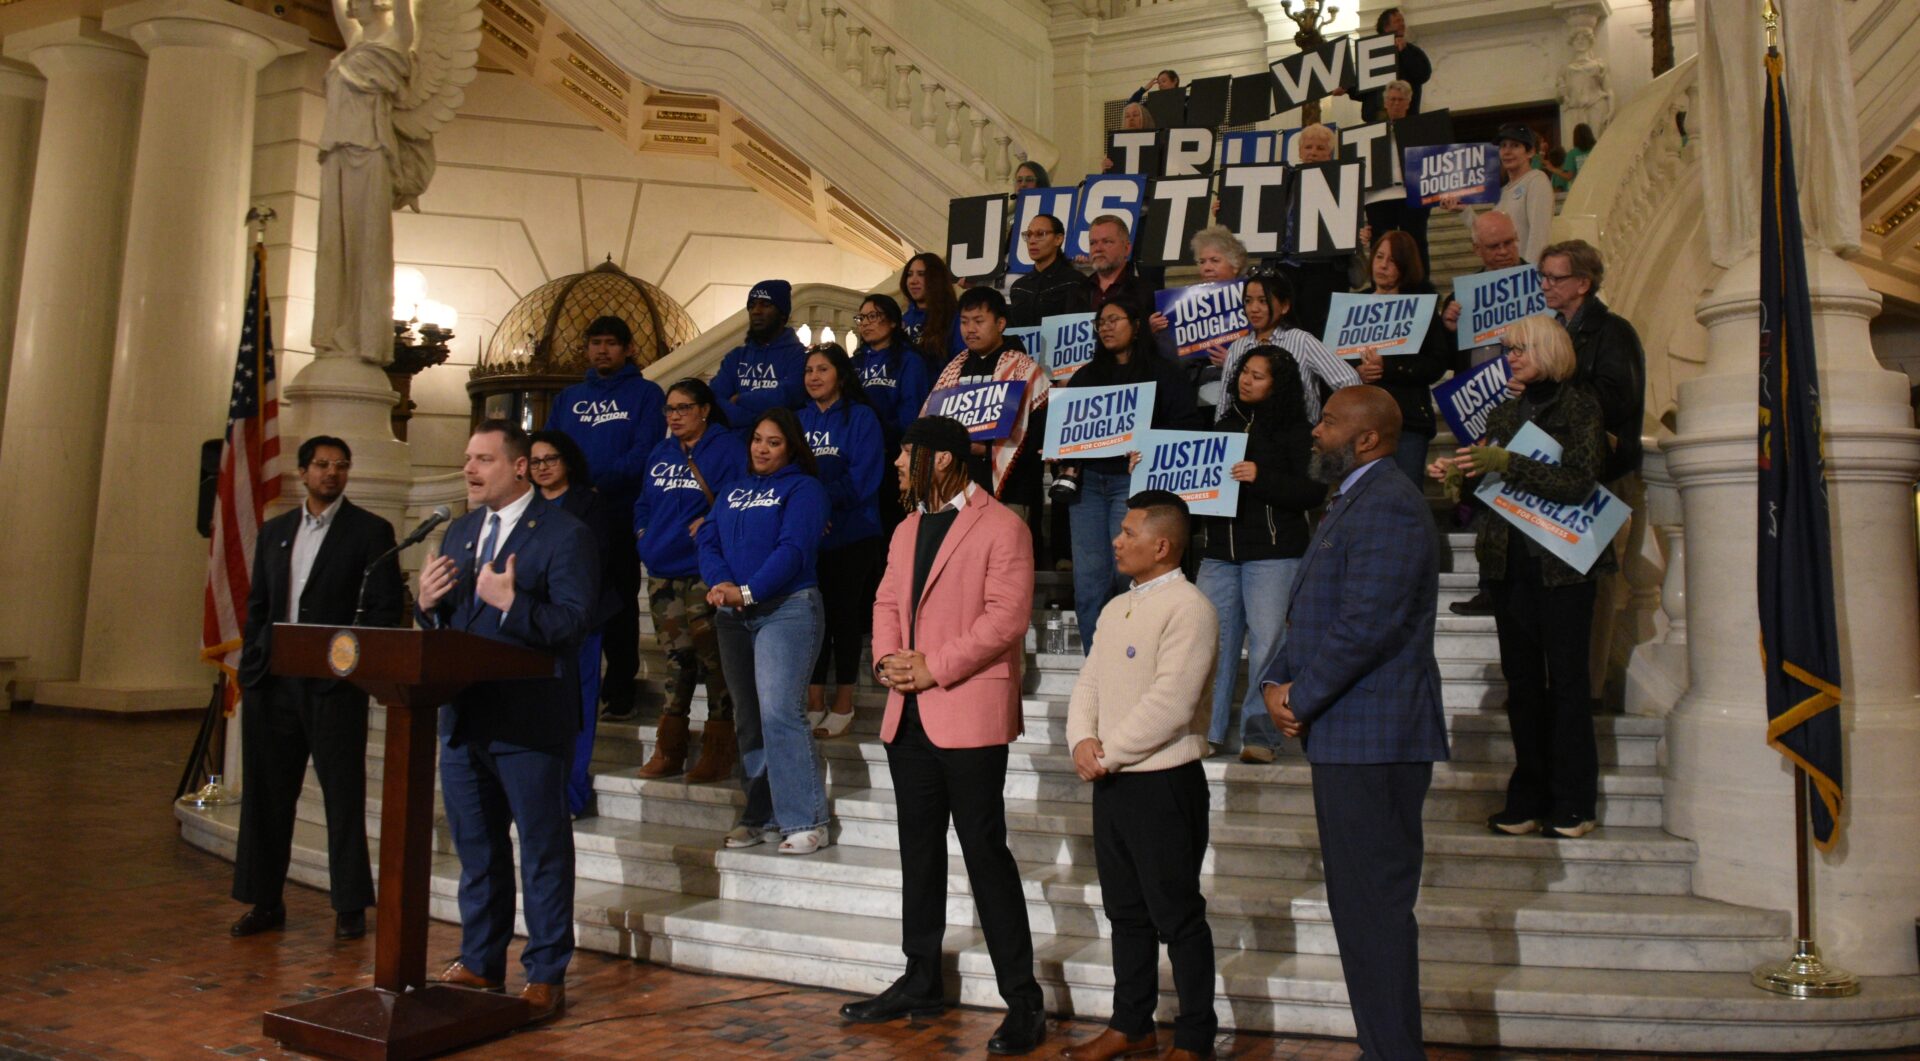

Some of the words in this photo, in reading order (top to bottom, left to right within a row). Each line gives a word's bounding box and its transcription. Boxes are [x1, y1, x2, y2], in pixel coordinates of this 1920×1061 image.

[1271, 34, 1397, 105] WE
[1420, 144, 1485, 179] JUSTIN
[1420, 167, 1486, 196] DOUGLAS
[1174, 281, 1244, 326] JUSTIN
[1342, 297, 1419, 329] JUSTIN
[1473, 292, 1546, 333] DOUGLAS
[1175, 308, 1249, 346] DOUGLAS
[1337, 321, 1413, 346] DOUGLAS
[940, 383, 1010, 416] JUSTIN
[1063, 386, 1138, 426] JUSTIN
[1450, 358, 1507, 422] JUSTIN
[572, 400, 619, 415] CASA
[580, 414, 592, 422] IN
[592, 411, 629, 424] ACTION
[1060, 412, 1136, 445] DOUGLAS
[1080, 443, 1093, 451] FOR
[1093, 436, 1124, 449] CONGRESS
[1149, 436, 1228, 472] JUSTIN
[1146, 466, 1223, 492] DOUGLAS
[1516, 508, 1531, 520] FOR
[1530, 515, 1569, 538] CONGRESS
